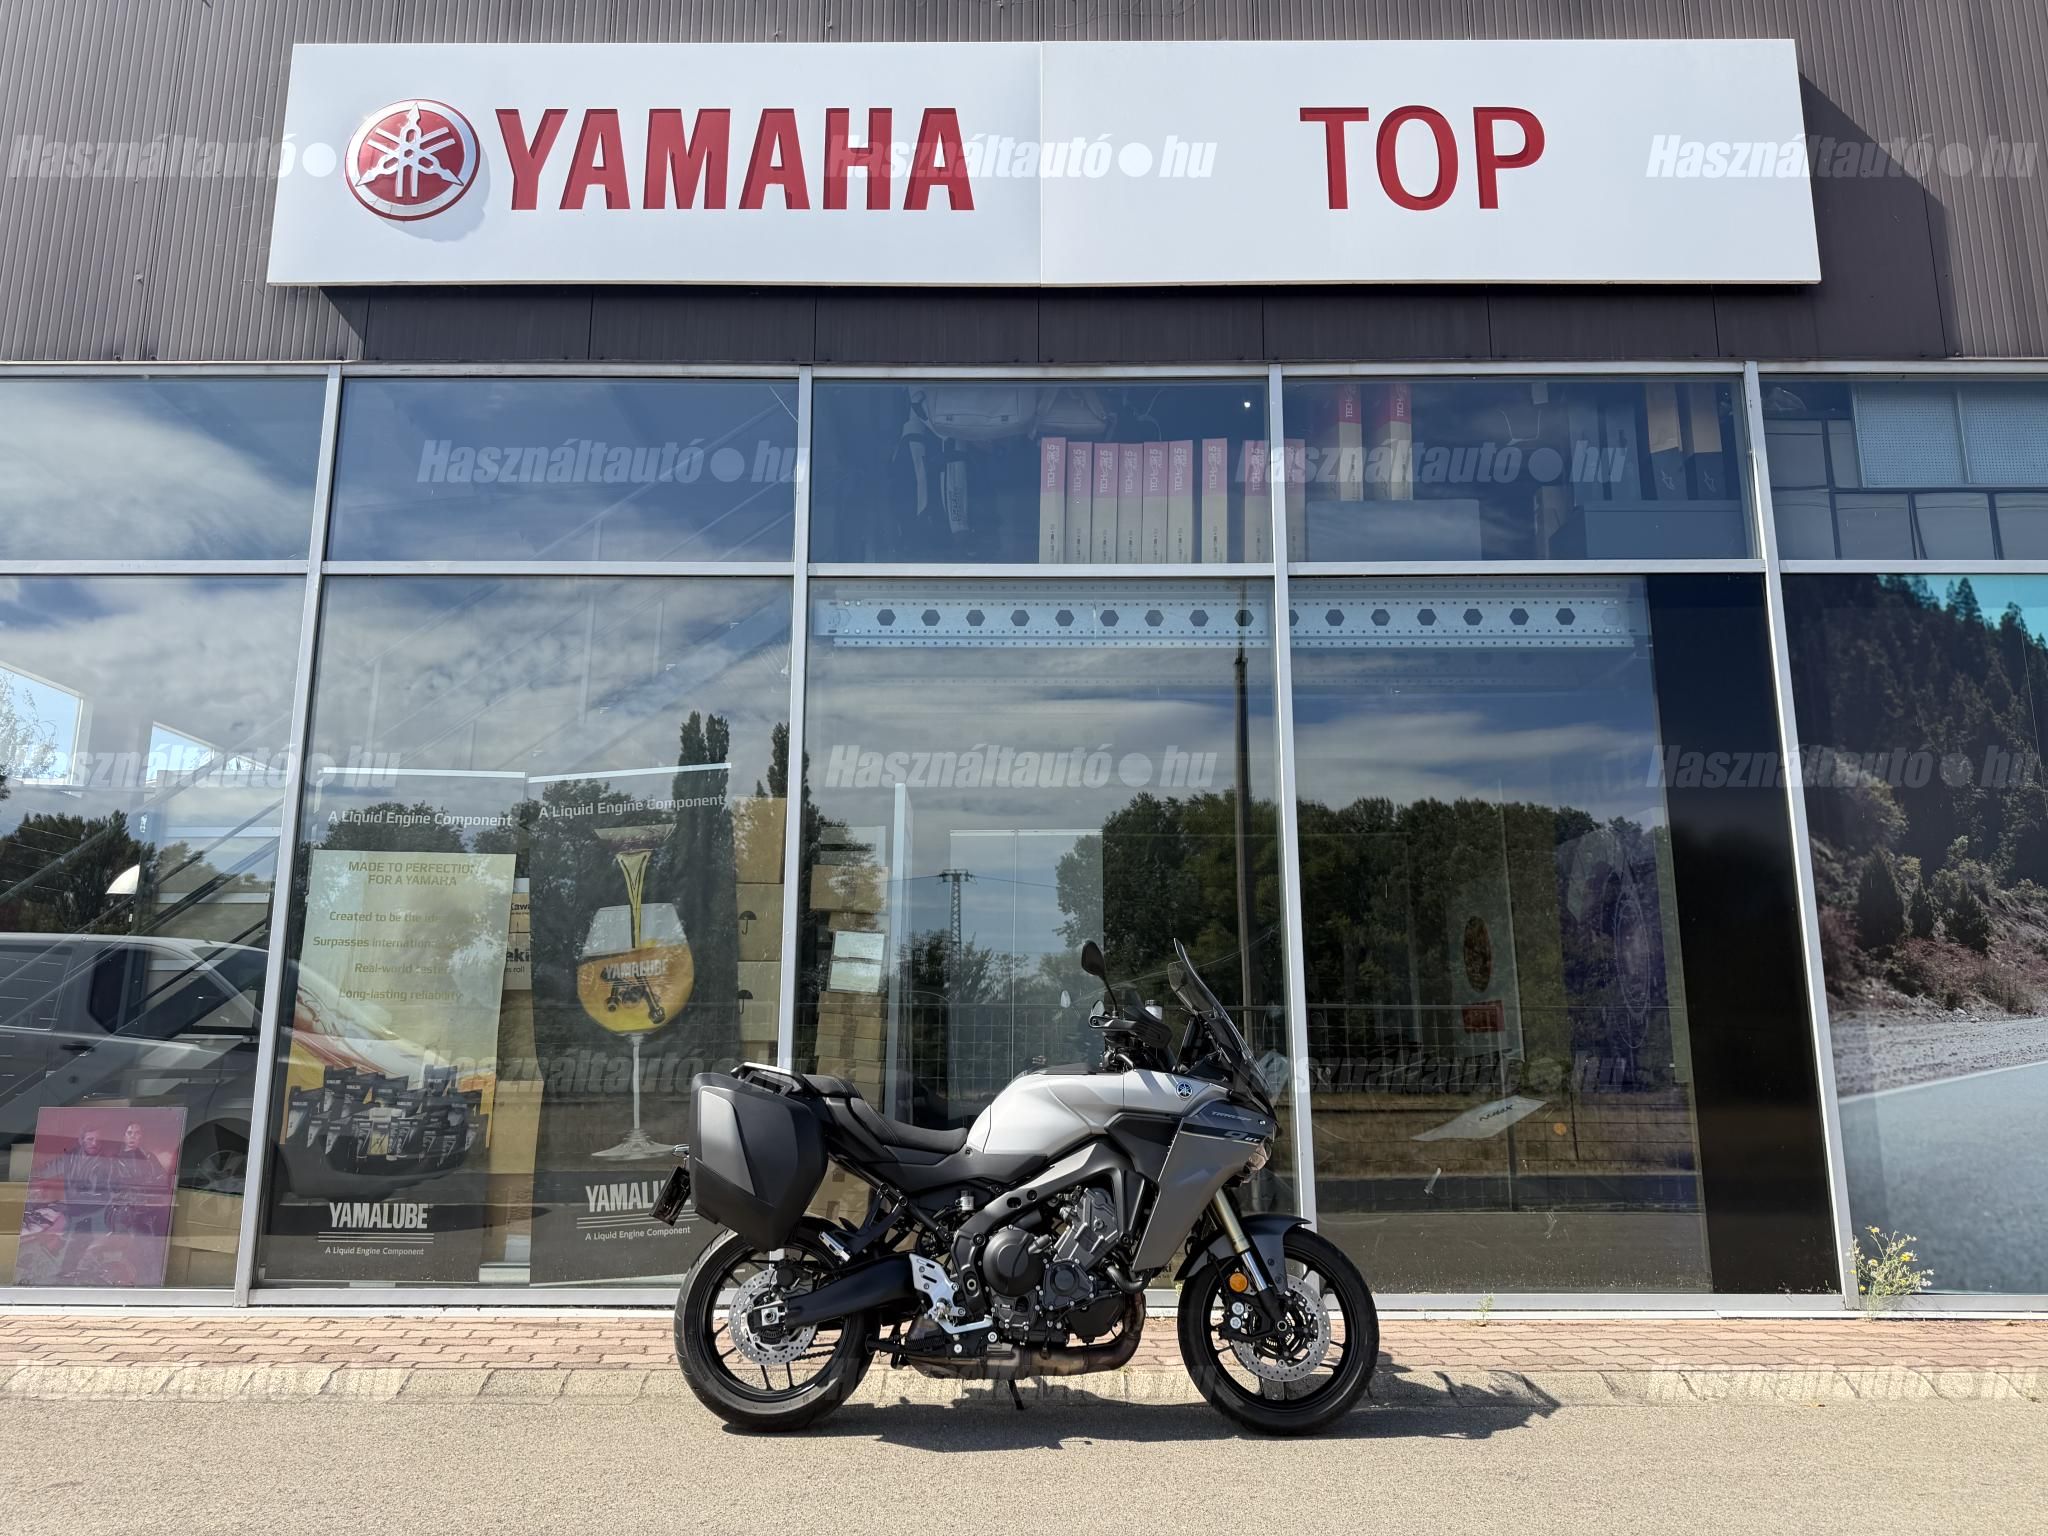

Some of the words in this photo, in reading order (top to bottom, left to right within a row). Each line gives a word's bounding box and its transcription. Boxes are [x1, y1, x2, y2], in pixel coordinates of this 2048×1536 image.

[494, 107, 976, 211] YAMAHA
[1299, 105, 1545, 211] TOP
[538, 807, 549, 819] A
[552, 803, 594, 819] Liquid
[597, 801, 643, 816] Engine
[647, 794, 725, 812] Component
[328, 811, 338, 822] A
[342, 811, 382, 826] Liquid
[386, 812, 430, 827] Engine
[434, 813, 512, 828] Component
[349, 861, 384, 872] MADE
[388, 862, 402, 872] TO
[405, 863, 480, 875] PERFECTION
[368, 875, 392, 885] FOR
[395, 875, 404, 885] A
[406, 876, 457, 886] YAMAHA
[329, 911, 372, 922] Created
[376, 912, 386, 922] to
[389, 911, 401, 922] be
[313, 936, 369, 948] Surpasses
[354, 962, 413, 974] Real-world
[338, 988, 407, 1001] Long-lasting
[329, 1202, 429, 1229] YAMALUBE
[585, 1233, 592, 1241] A
[593, 1231, 618, 1241] Liquid
[619, 1230, 645, 1239] Engine
[646, 1226, 691, 1237] Component
[325, 1246, 331, 1254] A
[333, 1246, 355, 1256] Liquid
[356, 1247, 380, 1256] Engine
[382, 1247, 424, 1257] Component
